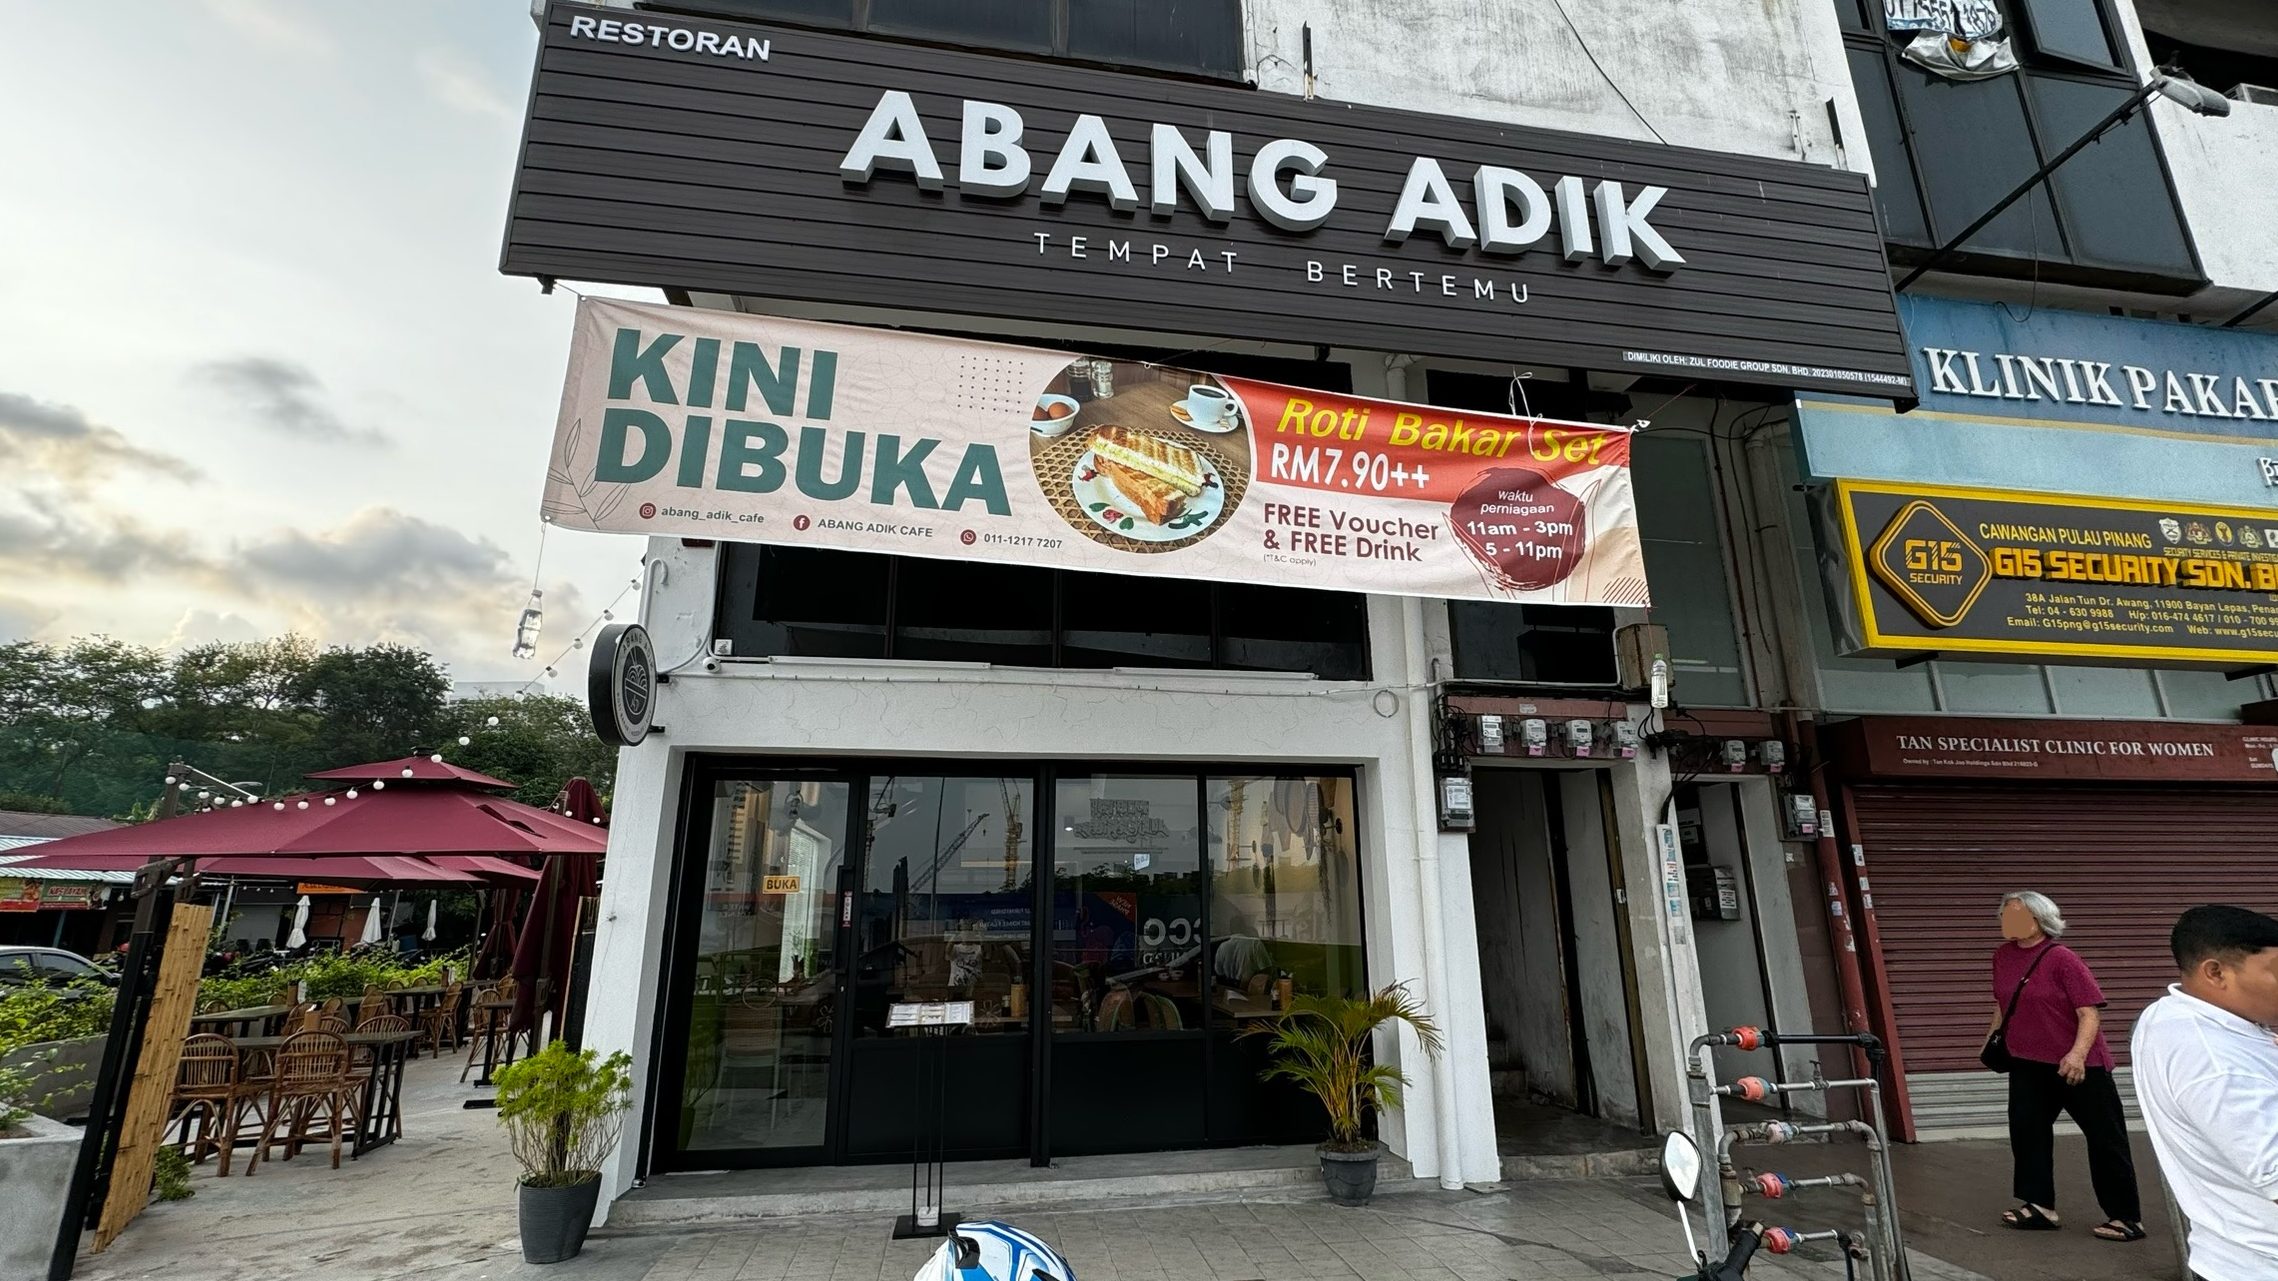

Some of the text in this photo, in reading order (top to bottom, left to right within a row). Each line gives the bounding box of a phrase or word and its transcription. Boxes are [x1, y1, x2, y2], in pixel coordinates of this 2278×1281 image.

[569, 15, 771, 62] RESTORAN
[839, 89, 1686, 273] ABANG ADIK
[1034, 232, 1529, 304] TEMPAT BERTEMU
[607, 327, 838, 421] KINI
[1627, 351, 1660, 363] DIMILIKI
[1662, 354, 1688, 366] OLEH:
[1689, 356, 1706, 368] ZUL
[1707, 358, 1739, 370] FOODIE
[1740, 361, 1770, 372] GROUP
[1771, 363, 1790, 375] SDN.
[1791, 365, 1811, 376] BHD.
[1922, 347, 2124, 407] KLINIK
[1276, 397, 1608, 466] Roti Bakar Set
[594, 408, 1013, 517] DIBUKA
[1270, 442, 1430, 491] RM7.90++
[1498, 490, 1534, 503] waktu
[661, 506, 765, 524] abang_adik_cafe
[1263, 502, 1439, 541] FREE Voucher
[1480, 503, 1555, 517] perniagaan
[817, 518, 933, 538] ABANG ADIK CAFE
[1467, 520, 1518, 536] 11am
[1534, 520, 1573, 537] 3pm
[1980, 522, 2153, 549] CAWANGAN PULAU PINANG
[983, 533, 1063, 549] 011-1217 7207
[1263, 529, 1423, 562] & FREE Drink
[1485, 542, 1498, 556] 5
[1515, 540, 1563, 561] 11pm
[1289, 556, 1317, 567] apply)
[1905, 539, 1963, 572] G15
[1909, 572, 1963, 585] SECURITY
[1993, 547, 2043, 578] G15
[2048, 550, 2180, 586] SECURITY
[2186, 558, 2252, 590] SDN.
[2025, 592, 2046, 603] 38A
[2048, 594, 2076, 605] Jalan
[2076, 595, 2097, 605] Tun
[2098, 596, 2114, 606] Dr.
[2116, 598, 2153, 610] Awang,
[2155, 599, 2183, 610] 11900
[2185, 601, 2216, 612] Bayan
[2218, 602, 2250, 614] Lepas,
[2007, 617, 2041, 628] Email:
[2042, 618, 2175, 635] G15png@g15security.com
[2187, 624, 2213, 635] Web:
[2025, 605, 2046, 615] Tel:
[2047, 606, 2060, 616] 04
[2069, 607, 2088, 617] 630
[2090, 608, 2114, 618] 9988
[2128, 610, 2150, 622] H/p:
[2151, 611, 2190, 622] 016-474
[2192, 612, 2215, 623] 4617
[2223, 614, 2241, 624] 010
[2249, 615, 2268, 626] 700
[1896, 735, 2215, 757] TAN SPECIALIST CLINIC FOR WOMEN
[765, 879, 798, 890] BUKA
